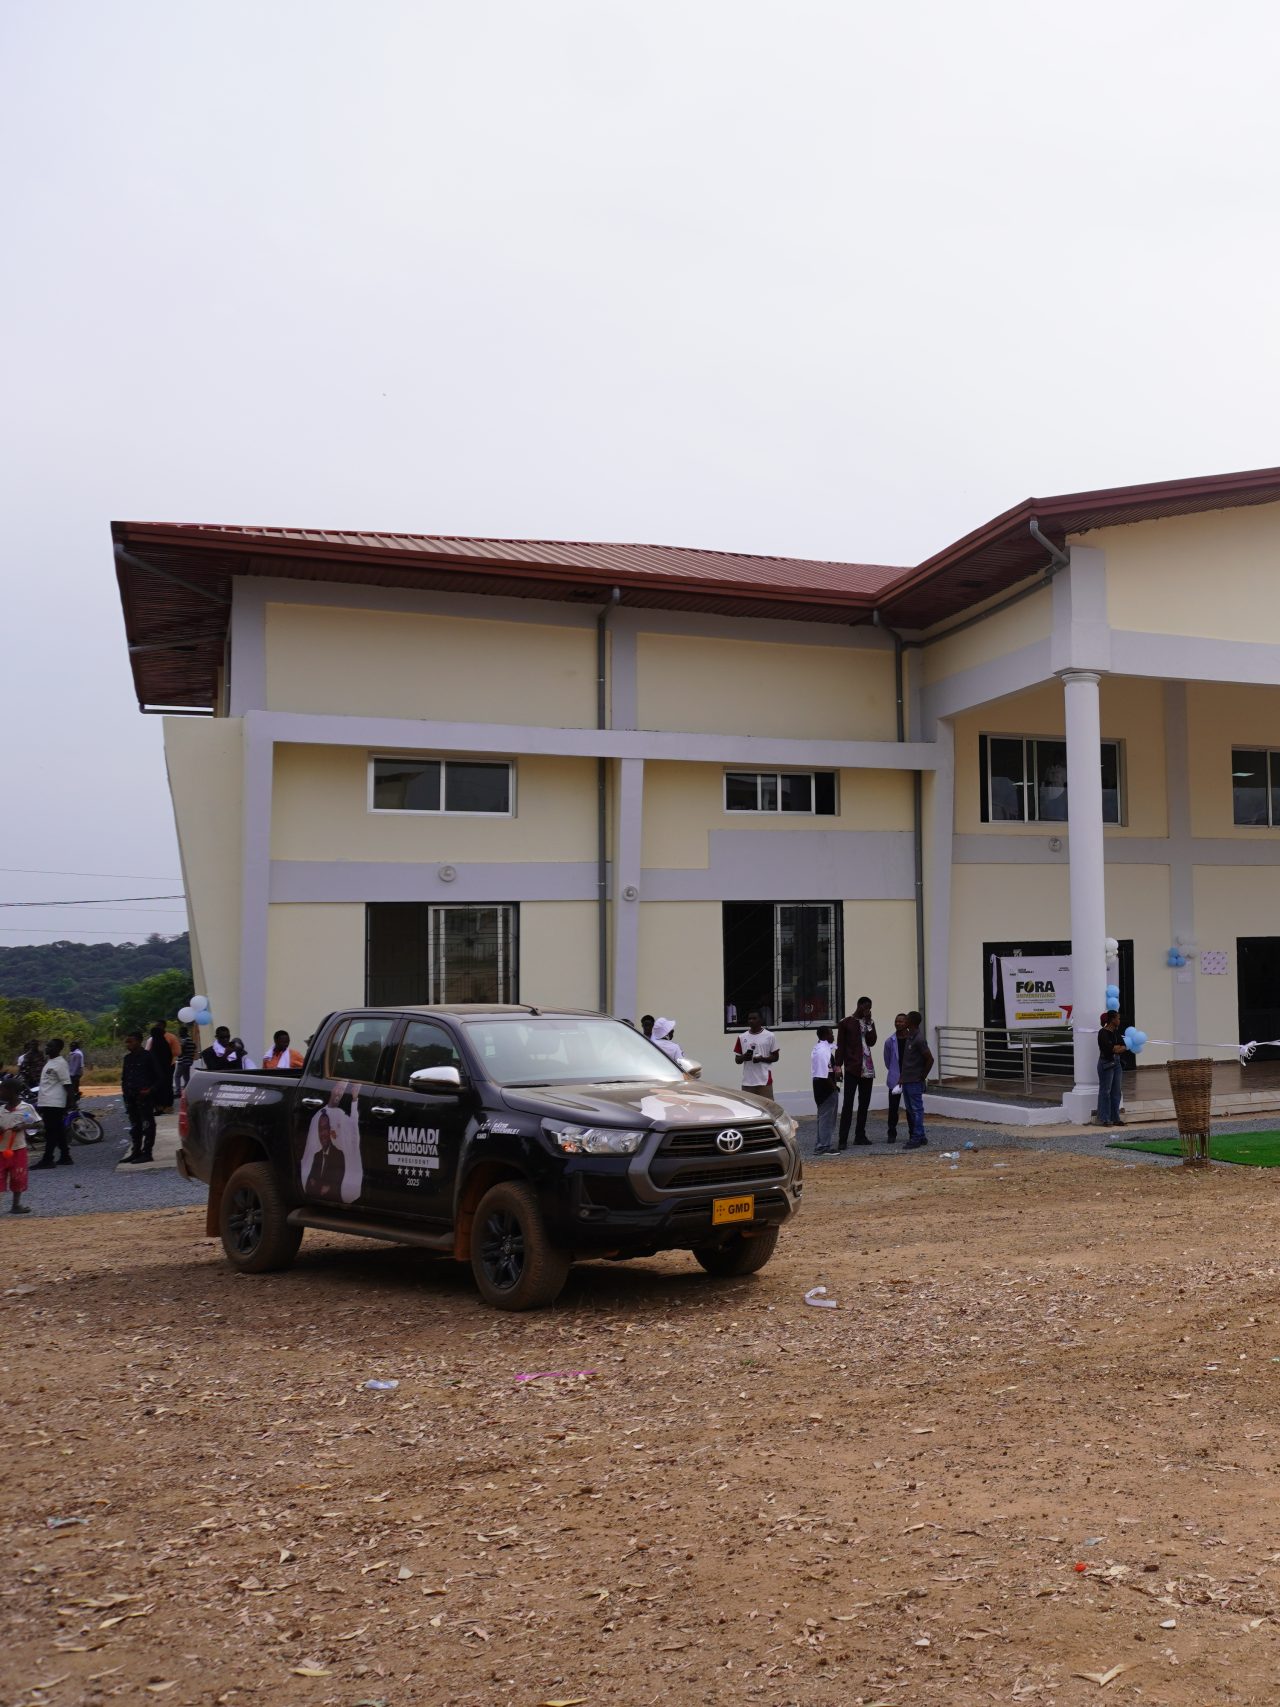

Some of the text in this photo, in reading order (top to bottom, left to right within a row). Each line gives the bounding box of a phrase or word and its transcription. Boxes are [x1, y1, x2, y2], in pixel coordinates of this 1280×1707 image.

[1016, 980, 1056, 993] FORA
[388, 1126, 440, 1145] MAMADI
[388, 1141, 439, 1156] DOUMBOUYA
[406, 1178, 420, 1187] 2025
[728, 1203, 750, 1215] GMD
